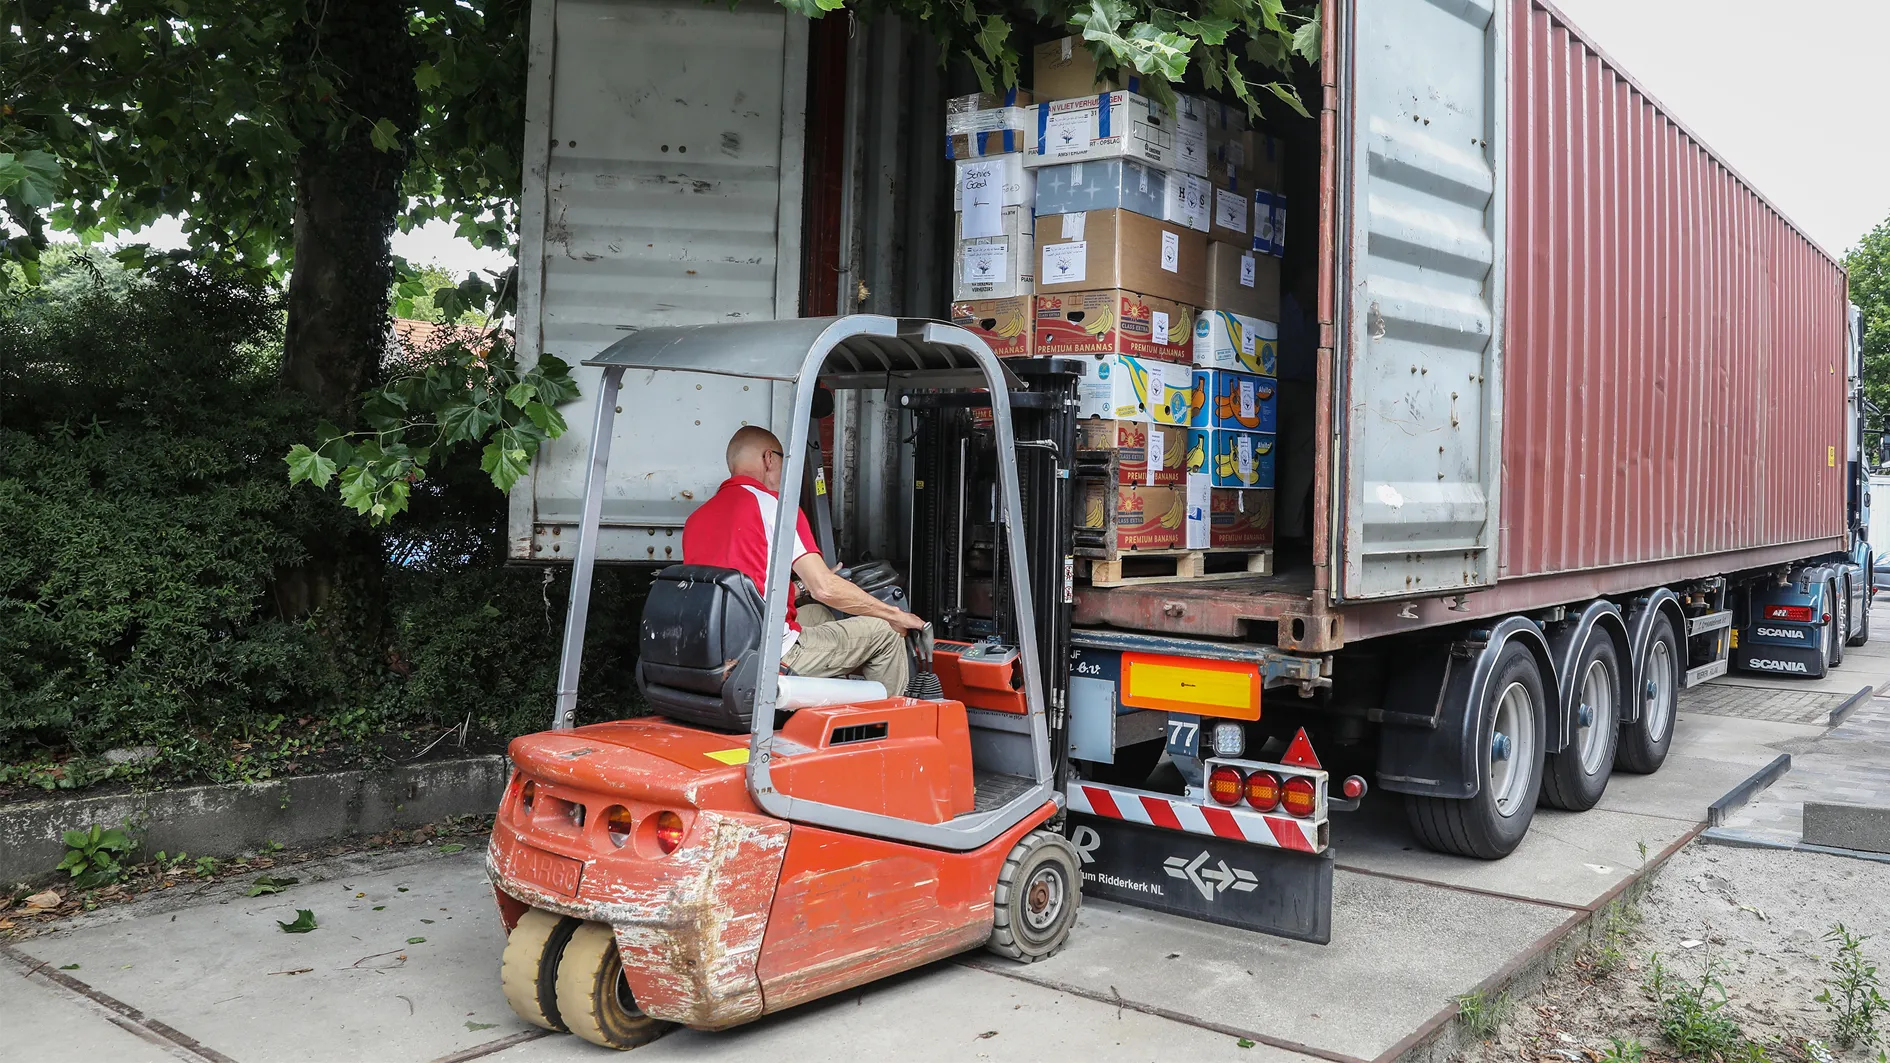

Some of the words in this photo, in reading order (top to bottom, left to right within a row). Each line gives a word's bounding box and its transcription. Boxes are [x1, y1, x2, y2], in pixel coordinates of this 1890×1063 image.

[1057, 101, 1075, 111] VLIET
[1075, 95, 1123, 109] VERHUIGEN
[1038, 296, 1062, 310] Dole
[1121, 297, 1150, 319] Dole
[1121, 323, 1134, 331] CLASS
[1134, 325, 1149, 333] EXTRA
[995, 346, 1025, 355] ANANAS
[1038, 344, 1072, 353] PREMIUM
[1074, 343, 1113, 352] BANANAS
[1130, 343, 1158, 353] PREMIUM
[1158, 348, 1185, 358] BANANAS
[1118, 427, 1145, 448] Dole
[1127, 472, 1148, 480] PREMIU
[1155, 472, 1179, 481] BANANAS
[1124, 535, 1152, 544] PREMIUM
[1154, 534, 1179, 542] BANANAS
[1219, 534, 1243, 542] PREMIUM
[1244, 533, 1265, 541] BANANAS
[1757, 627, 1805, 639] SCANIA
[1749, 658, 1808, 673] SCANIA
[1168, 720, 1199, 747] 77
[514, 848, 577, 891] CARGO
[1081, 870, 1096, 882] um
[1098, 873, 1149, 893] Ridderkerk
[1150, 883, 1164, 896] NL
